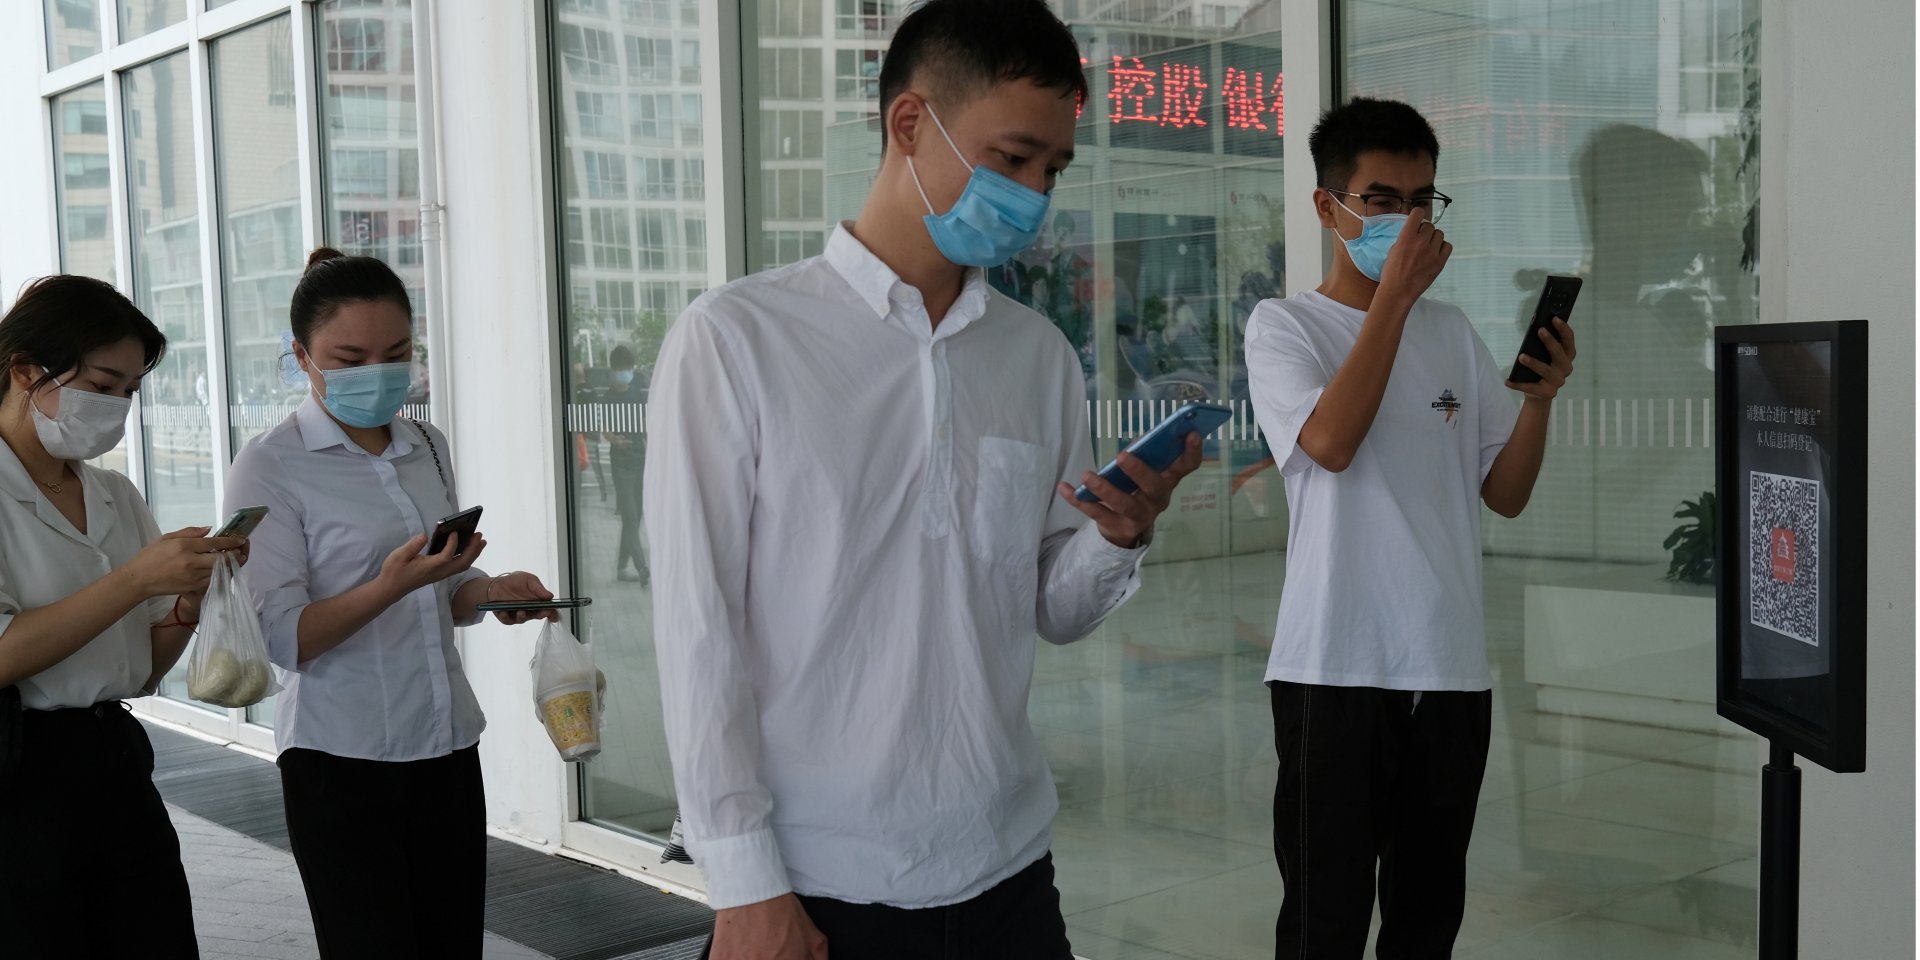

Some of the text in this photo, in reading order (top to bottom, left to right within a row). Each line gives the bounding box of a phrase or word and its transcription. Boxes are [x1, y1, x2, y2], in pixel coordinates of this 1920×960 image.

[1756, 429, 1813, 452] 本人信息扫码登记
